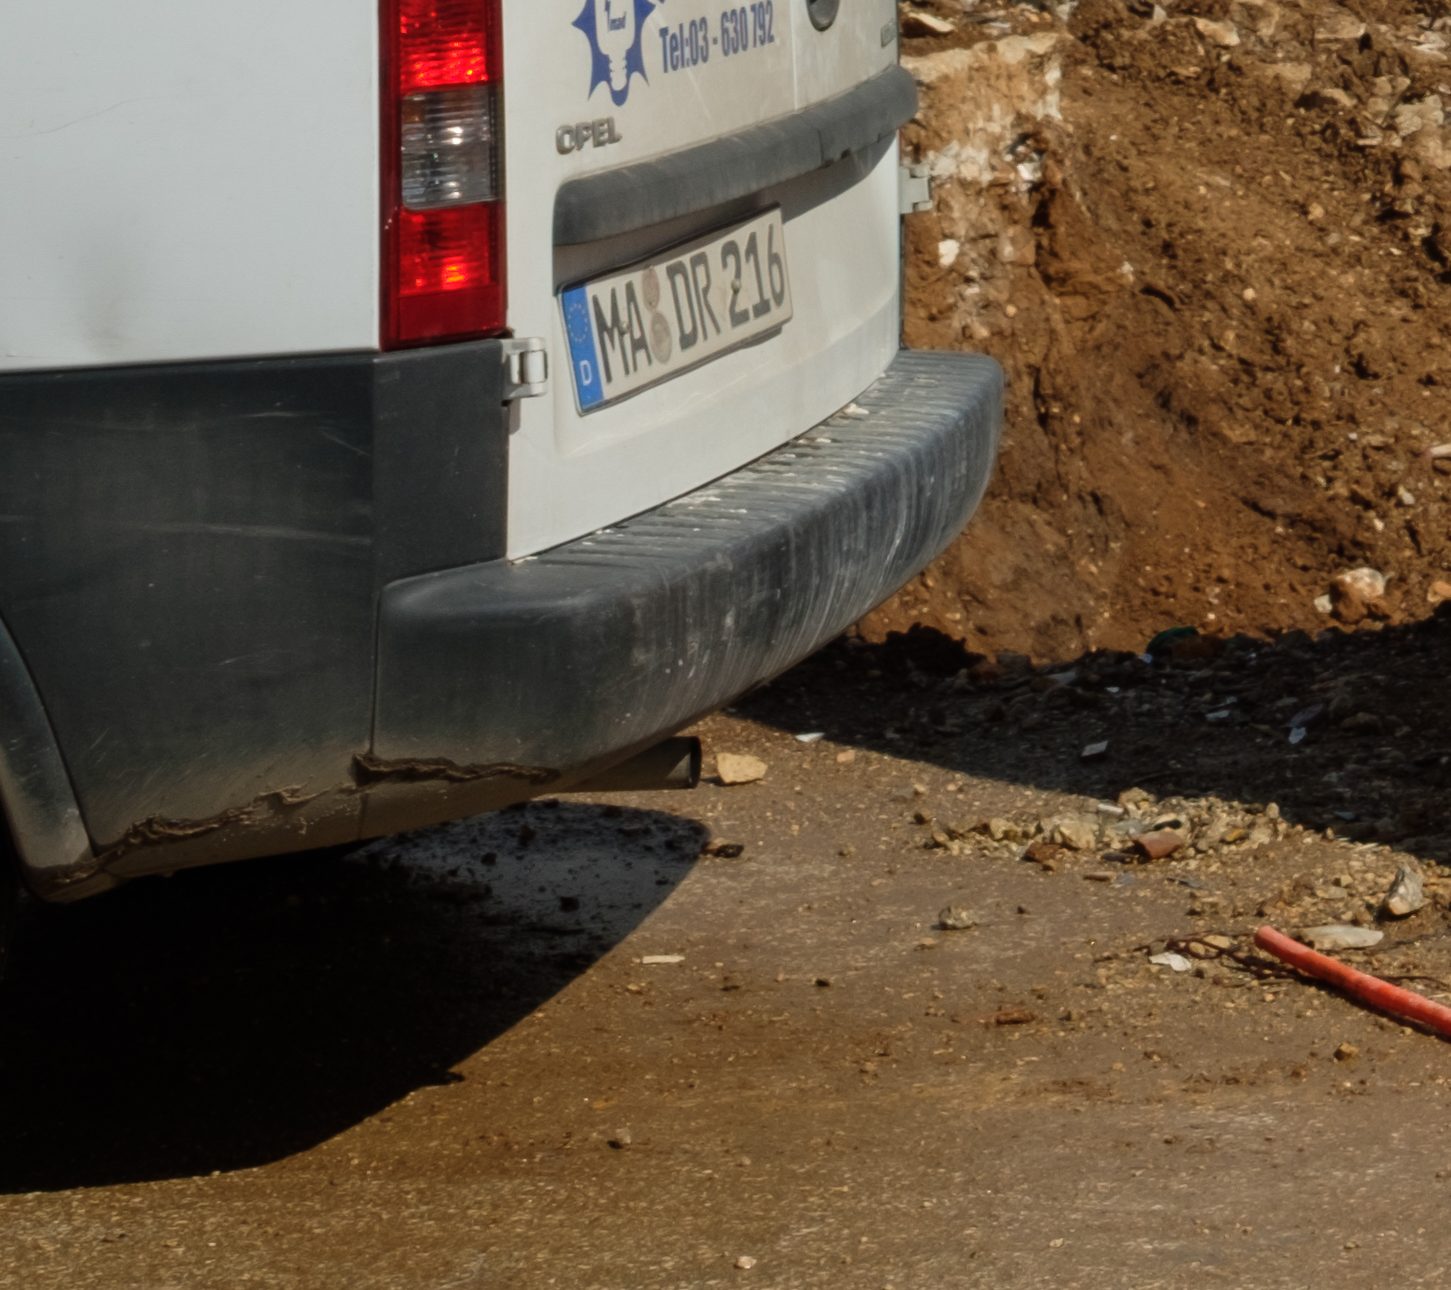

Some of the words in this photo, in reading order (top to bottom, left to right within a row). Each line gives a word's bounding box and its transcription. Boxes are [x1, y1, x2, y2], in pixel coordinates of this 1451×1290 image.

[721, 6, 749, 58] 630
[555, 116, 622, 155] OPEL
[592, 280, 653, 385] MA
[665, 251, 721, 352] DR
[720, 223, 786, 329] 216
[580, 360, 593, 386] D
